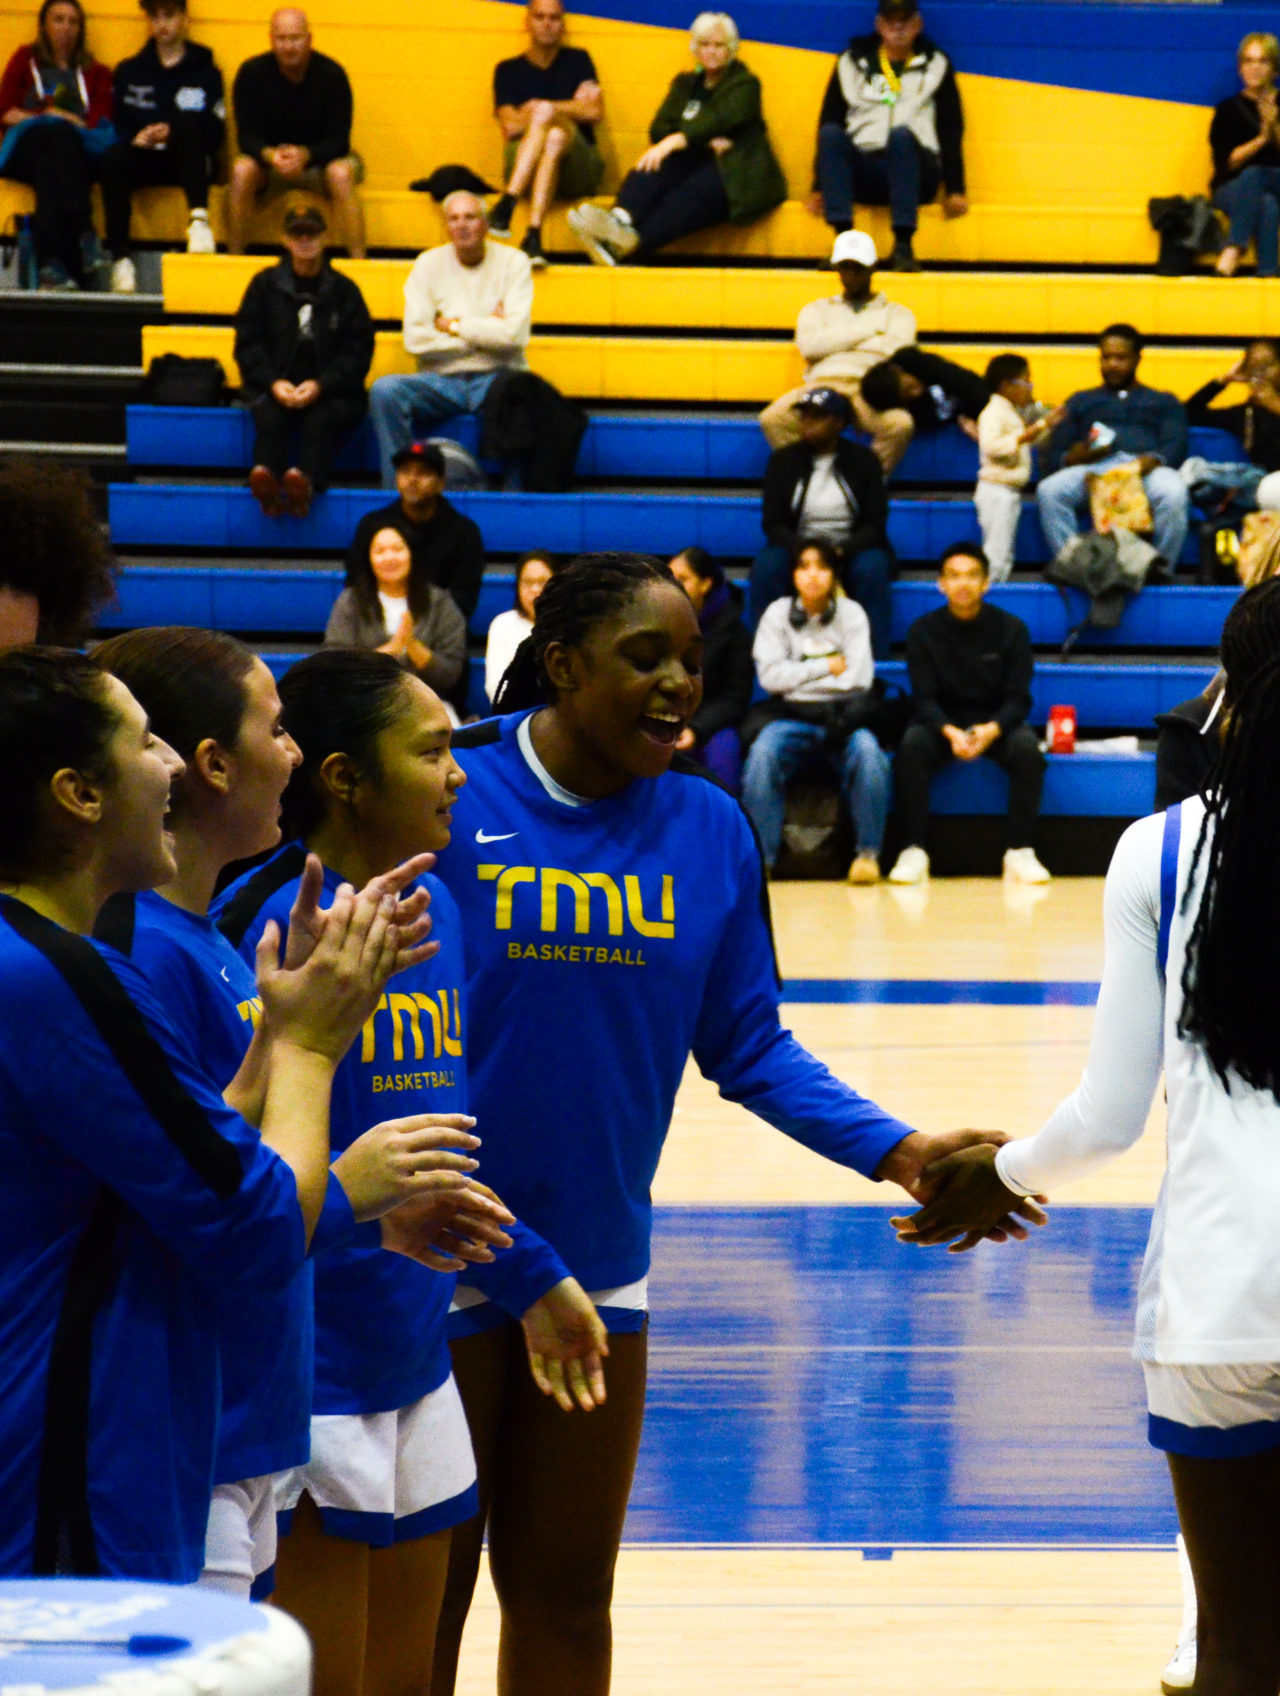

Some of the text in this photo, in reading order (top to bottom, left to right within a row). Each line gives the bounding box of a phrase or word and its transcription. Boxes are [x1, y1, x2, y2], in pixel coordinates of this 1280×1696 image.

[476, 863, 676, 940] TMU
[507, 942, 647, 966] BASKETBALL
[361, 988, 463, 1064] TMU
[372, 1070, 456, 1094] BASKETBALL
